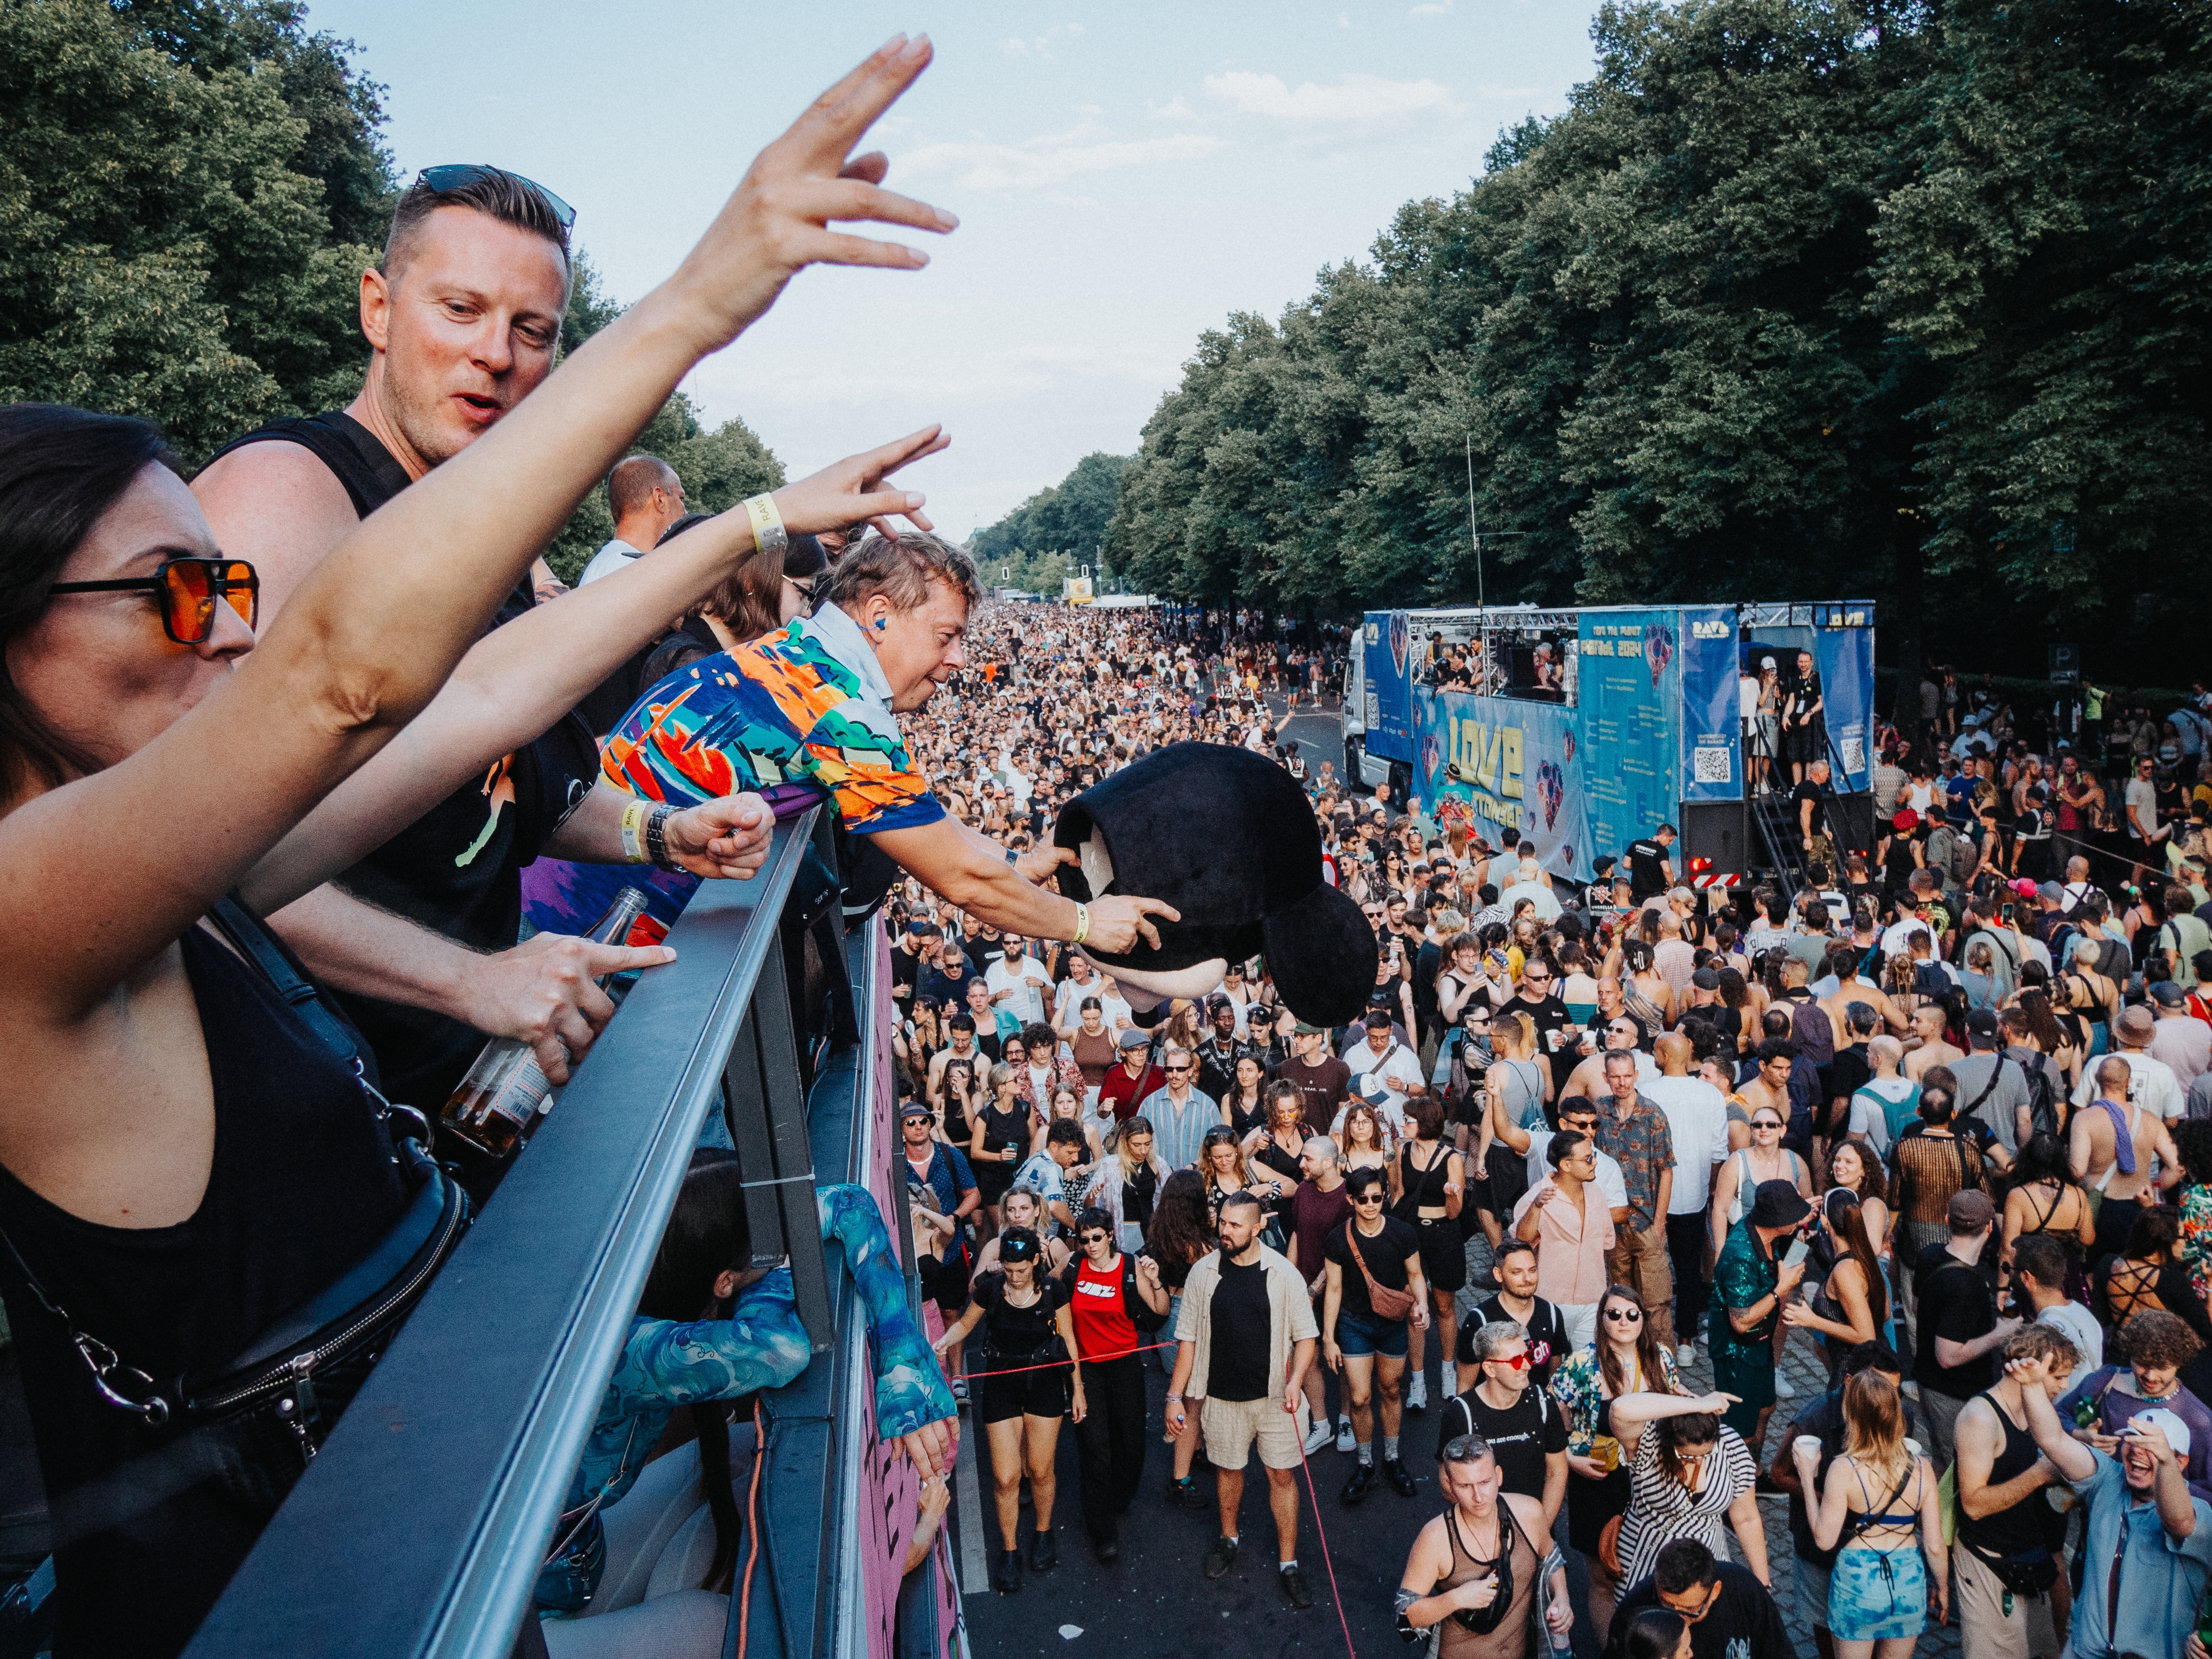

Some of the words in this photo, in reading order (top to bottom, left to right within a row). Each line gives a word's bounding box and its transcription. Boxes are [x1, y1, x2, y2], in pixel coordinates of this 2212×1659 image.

[754, 499, 770, 521] RAVE
[1618, 640, 1641, 657] 2024
[2056, 648, 2070, 667] P
[626, 808, 634, 825] RAVE
